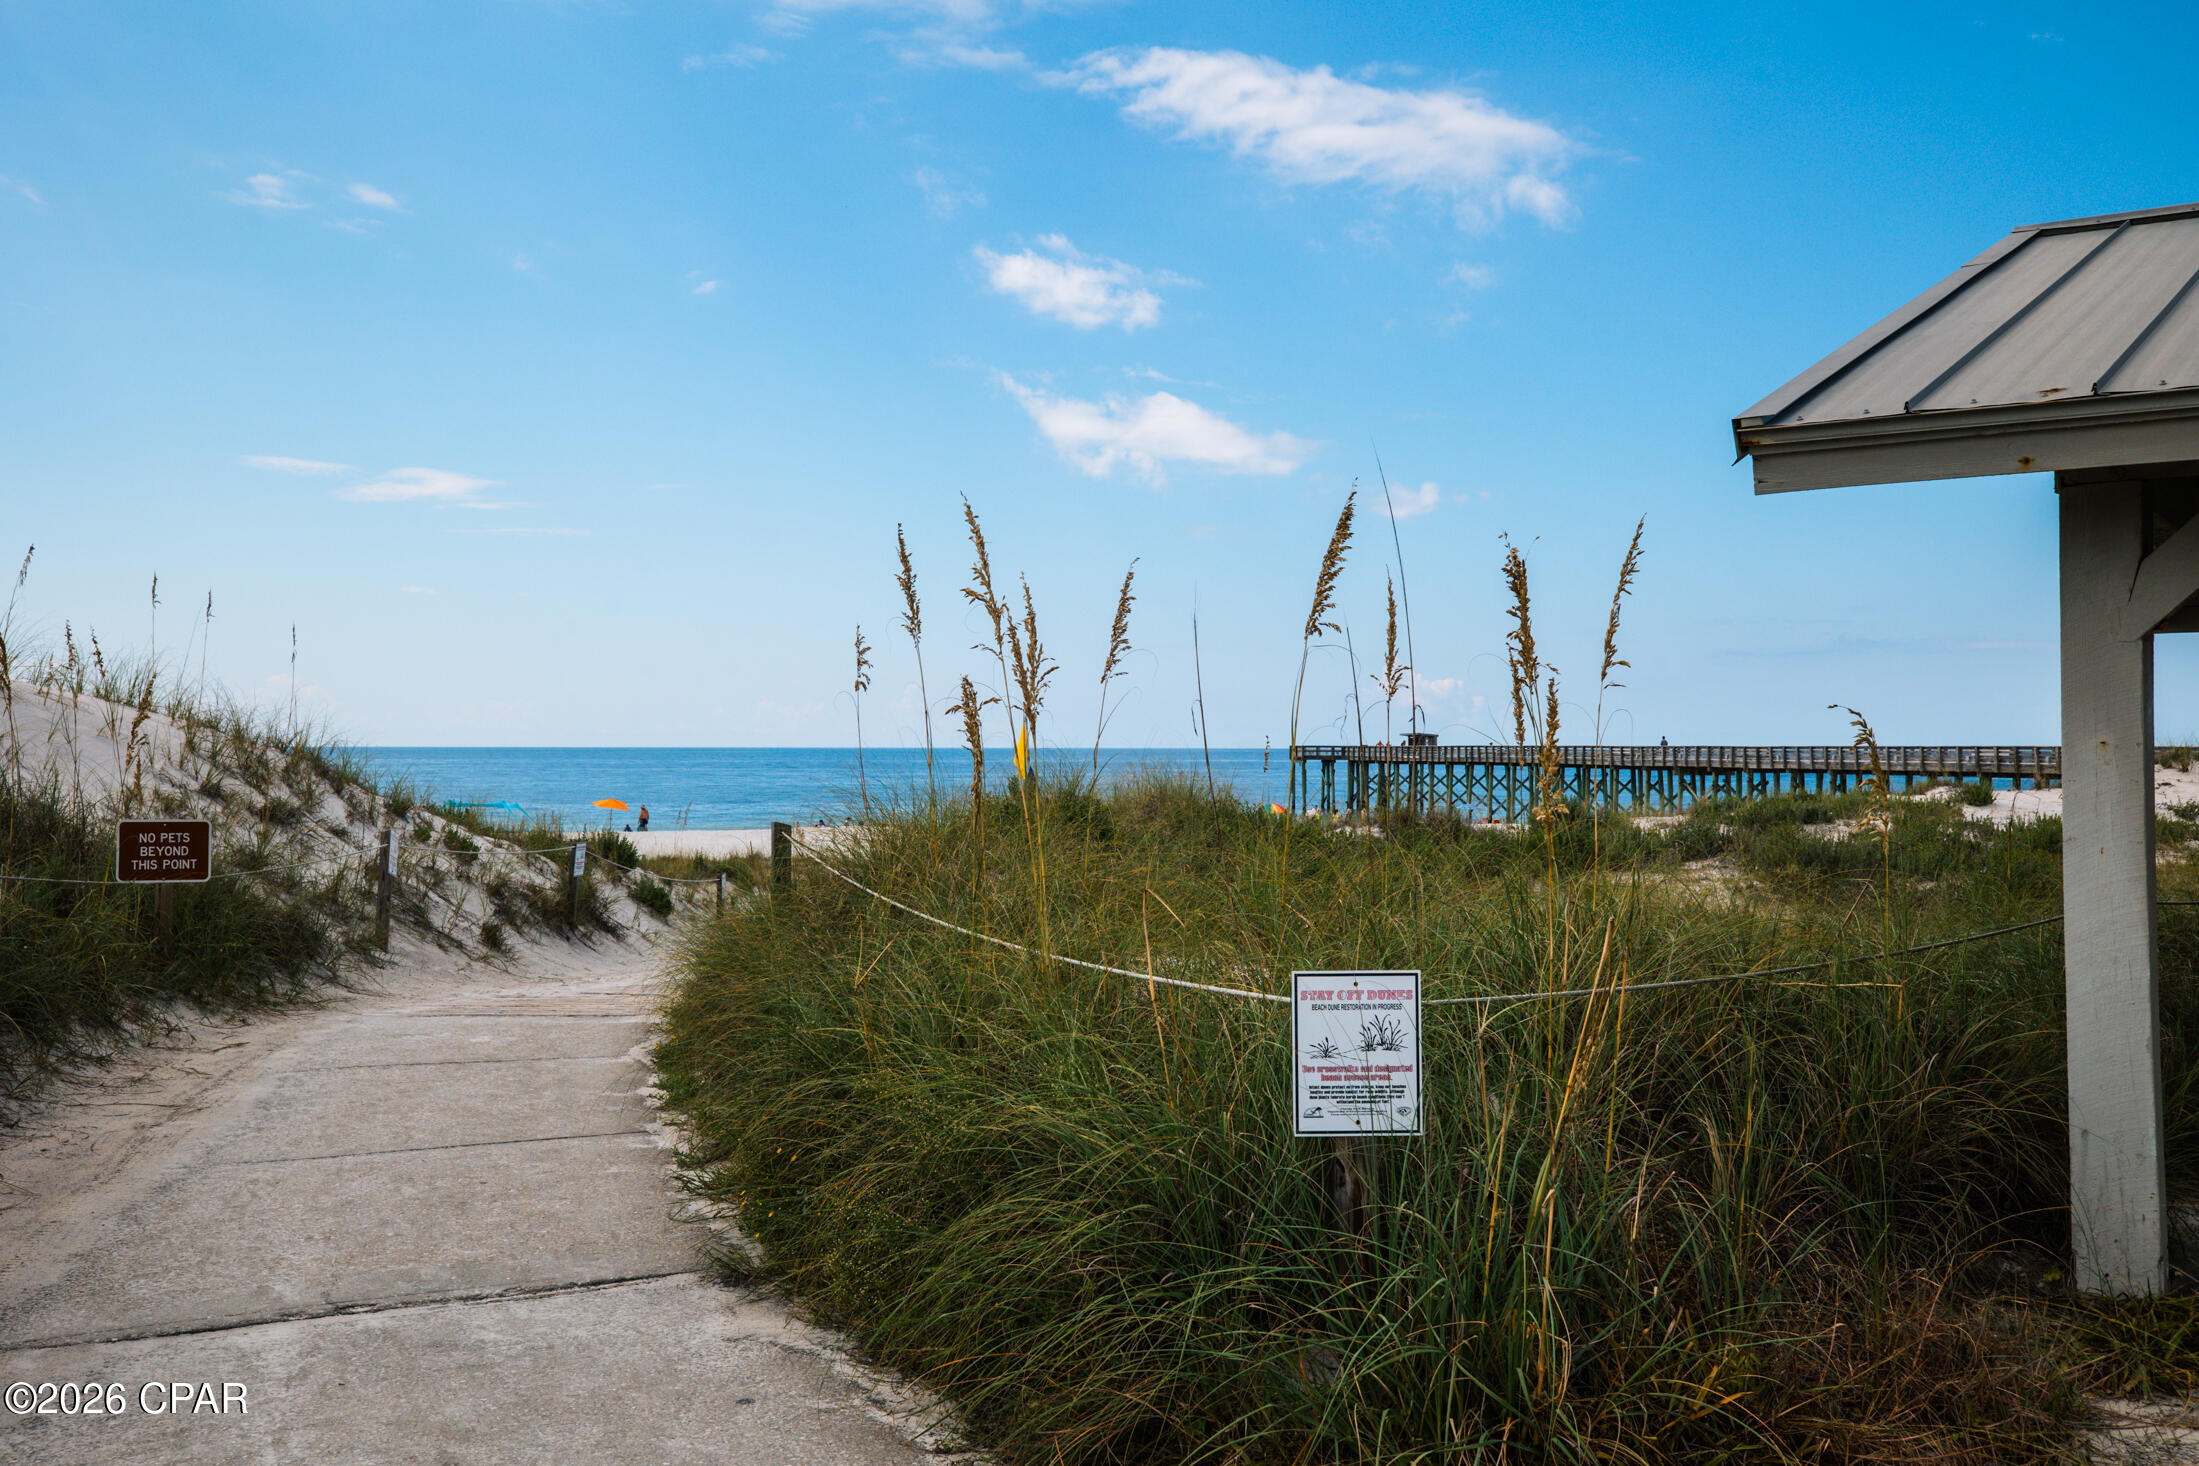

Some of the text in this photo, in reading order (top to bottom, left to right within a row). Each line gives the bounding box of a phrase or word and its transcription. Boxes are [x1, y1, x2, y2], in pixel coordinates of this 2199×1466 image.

[139, 833, 190, 843] NO PETS
[140, 846, 188, 856] BEYOND
[131, 859, 197, 870] THIS POINT
[1301, 990, 1413, 1000] STAY OFF DUNES
